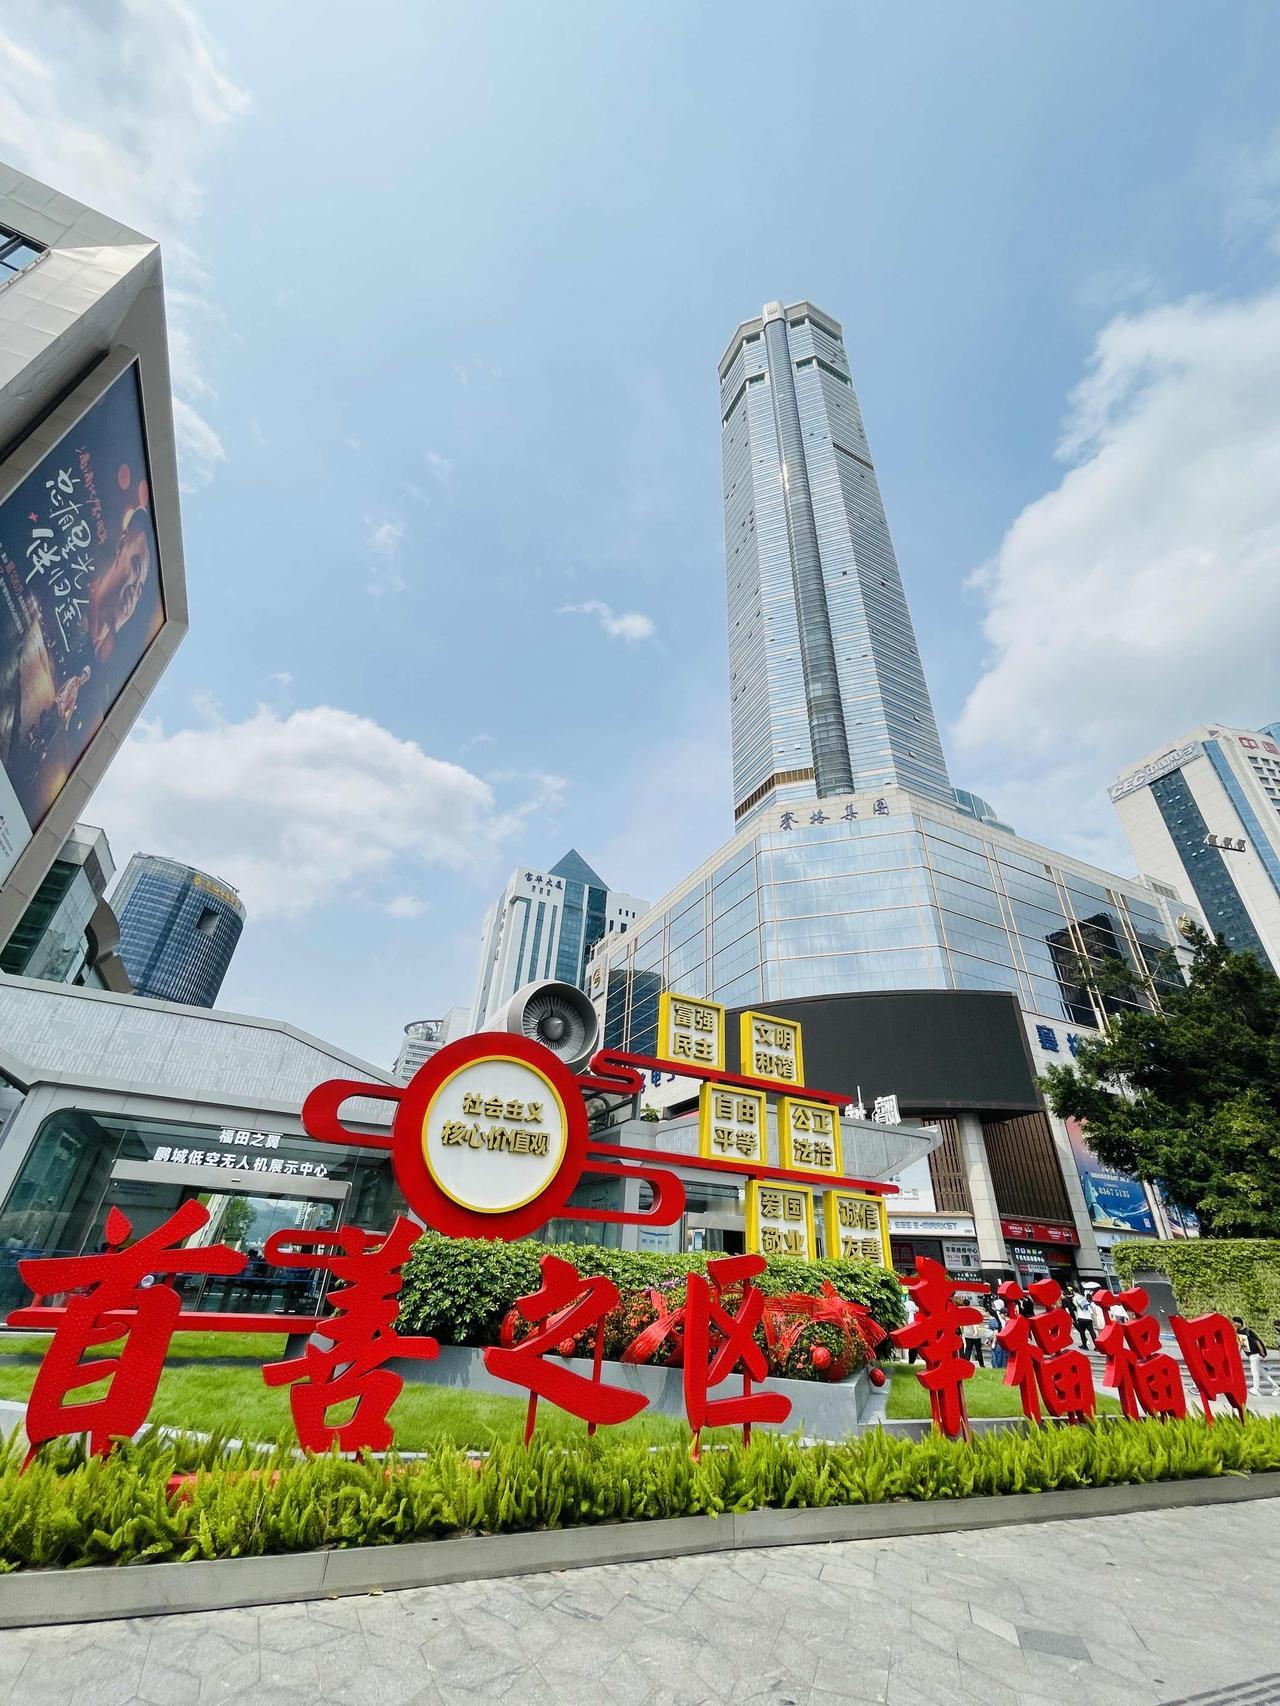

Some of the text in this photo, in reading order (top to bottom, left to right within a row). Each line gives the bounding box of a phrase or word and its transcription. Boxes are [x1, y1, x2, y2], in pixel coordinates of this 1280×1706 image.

[1111, 772, 1146, 798] CEC
[673, 1002, 715, 1034] 富强
[673, 1031, 715, 1062] 民主
[754, 1023, 794, 1051] 文明
[755, 1051, 796, 1080] 和谐
[462, 1090, 545, 1124] 社会主义
[715, 1093, 757, 1124] 自由
[792, 1106, 831, 1136] 公正
[218, 1127, 281, 1150] 福田之翼
[441, 1119, 551, 1157] 核心价值观
[714, 1126, 758, 1157] 平等
[793, 1137, 833, 1167] 法治
[152, 1145, 328, 1178] 鹏城低空无人机展示中心
[760, 1191, 803, 1221] 爱国
[838, 1199, 878, 1230] 诚信
[760, 1225, 806, 1257] 敬业
[841, 1233, 883, 1266] 友善
[18, 1199, 1247, 1456] 首善之区 幸福福田
